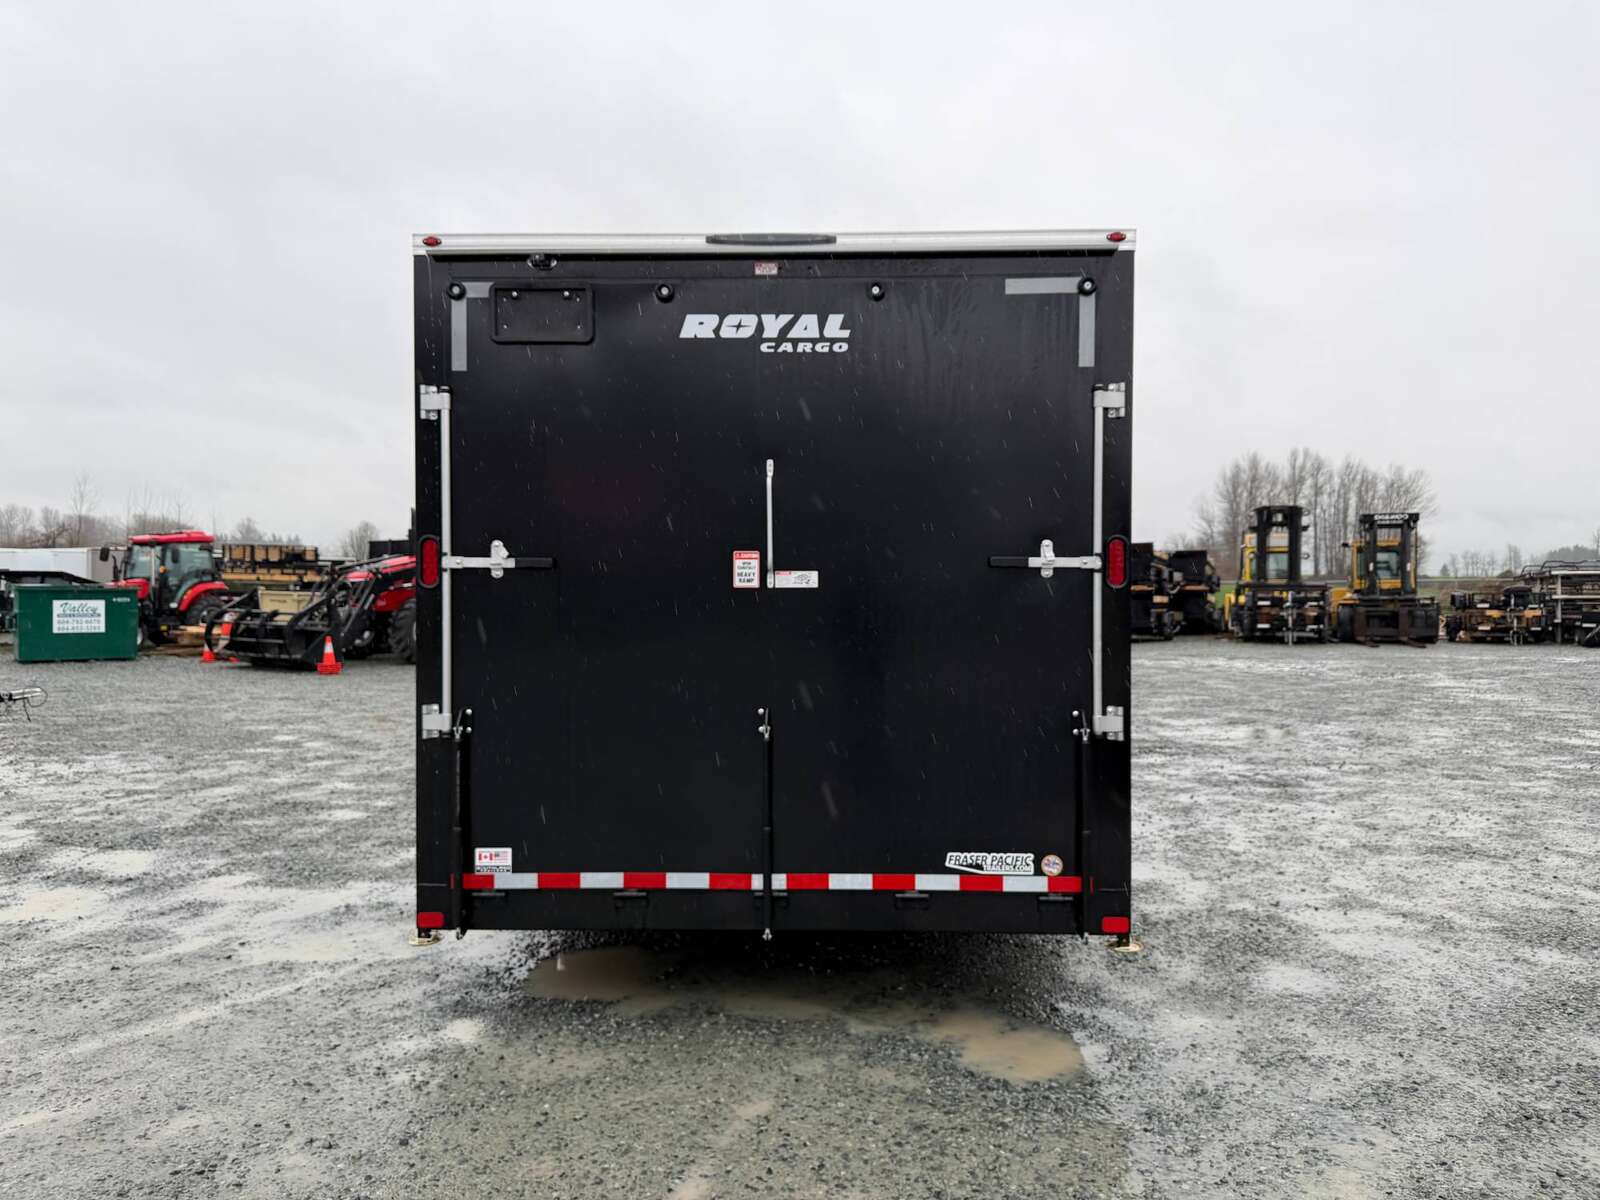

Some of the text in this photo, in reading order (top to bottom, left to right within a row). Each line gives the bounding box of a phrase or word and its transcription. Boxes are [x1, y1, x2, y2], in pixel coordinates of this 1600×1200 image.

[679, 314, 851, 339] ROYAL
[759, 342, 849, 353] CARGO
[60, 602, 97, 614] Valley
[948, 855, 988, 866] FRASER
[991, 854, 1032, 866] PACIFIC
